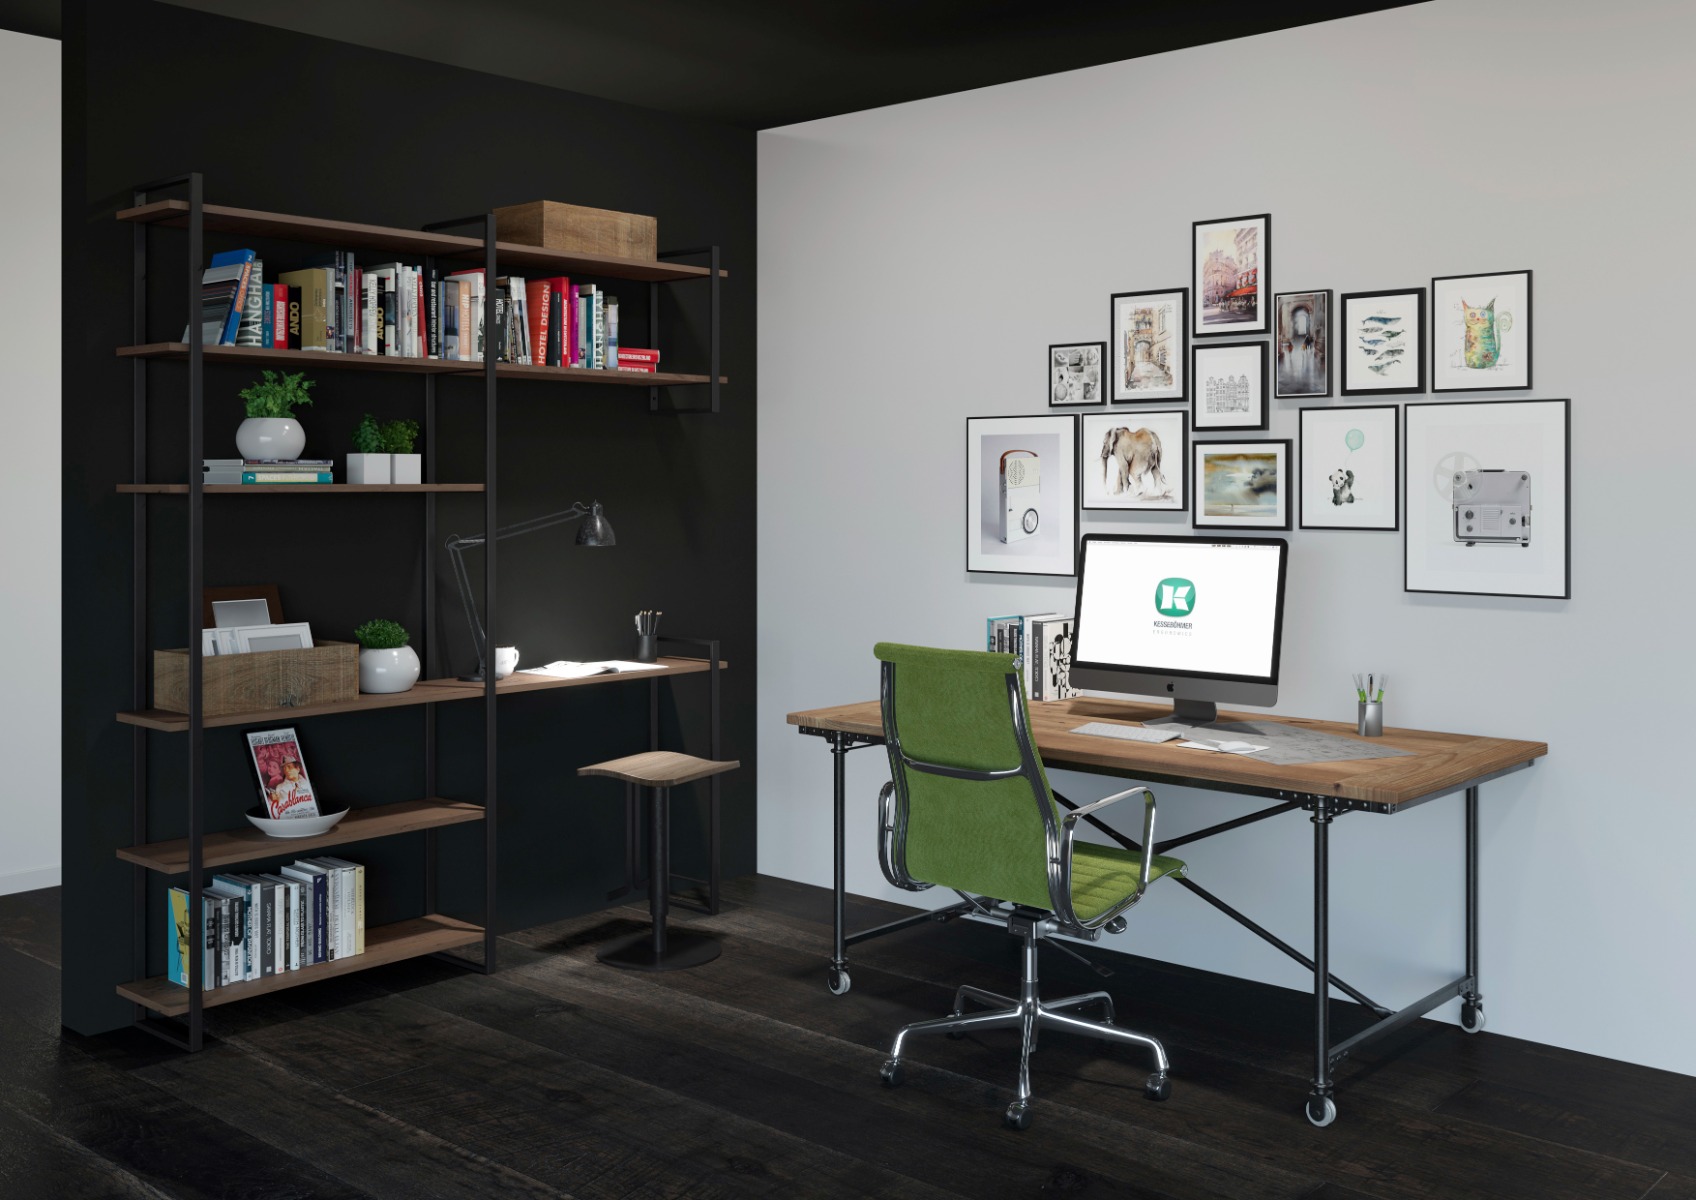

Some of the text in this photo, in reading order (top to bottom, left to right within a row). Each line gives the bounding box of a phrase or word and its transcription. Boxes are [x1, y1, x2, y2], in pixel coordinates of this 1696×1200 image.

[461, 293, 470, 309] HIP
[495, 298, 504, 315] HOTEL
[289, 301, 300, 335] ANDO
[376, 307, 384, 340] ANDO
[538, 284, 551, 364] HOTEL DESIGN
[1153, 620, 1193, 630] KESSEBÖHMER
[270, 789, 312, 819] Casablanca
